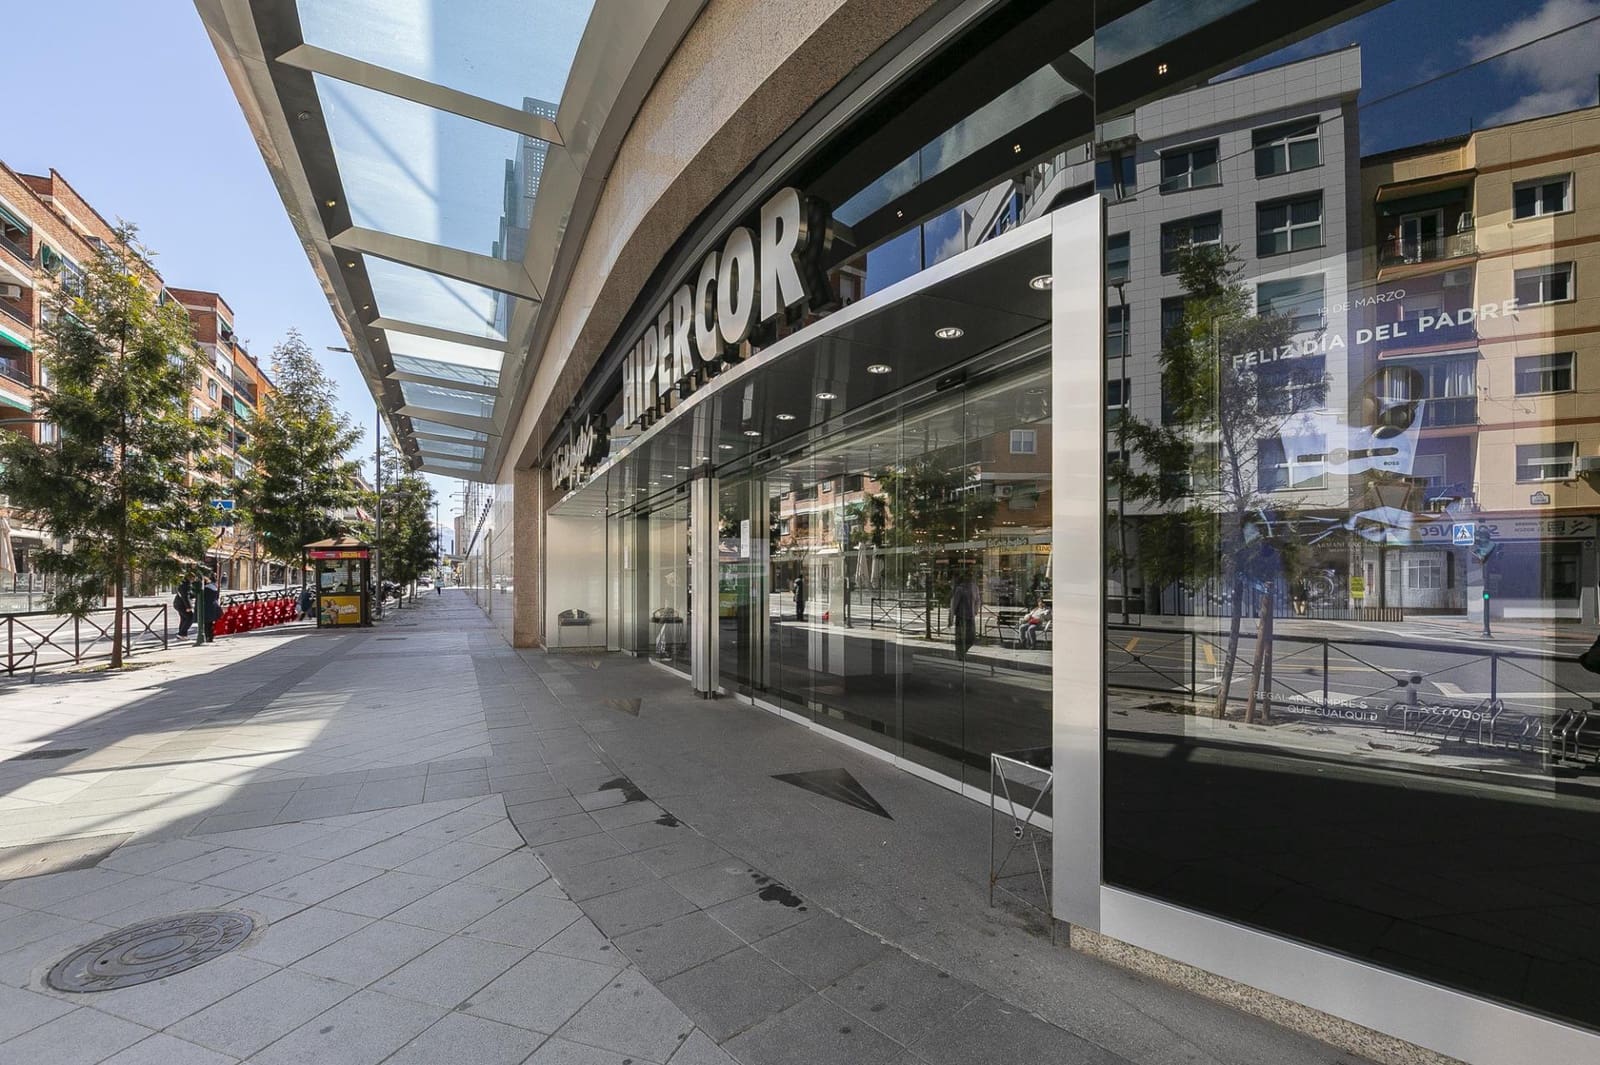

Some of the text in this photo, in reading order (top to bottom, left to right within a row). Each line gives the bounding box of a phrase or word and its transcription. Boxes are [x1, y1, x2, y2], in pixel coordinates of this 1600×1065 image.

[623, 186, 805, 431] HIPERCOR
[1332, 301, 1351, 313] DE
[1354, 289, 1406, 308] MARZO
[1232, 343, 1294, 369] FELIZ
[1355, 322, 1408, 345] DEL
[1418, 297, 1520, 333] PADRE
[1287, 704, 1312, 714] QUE
